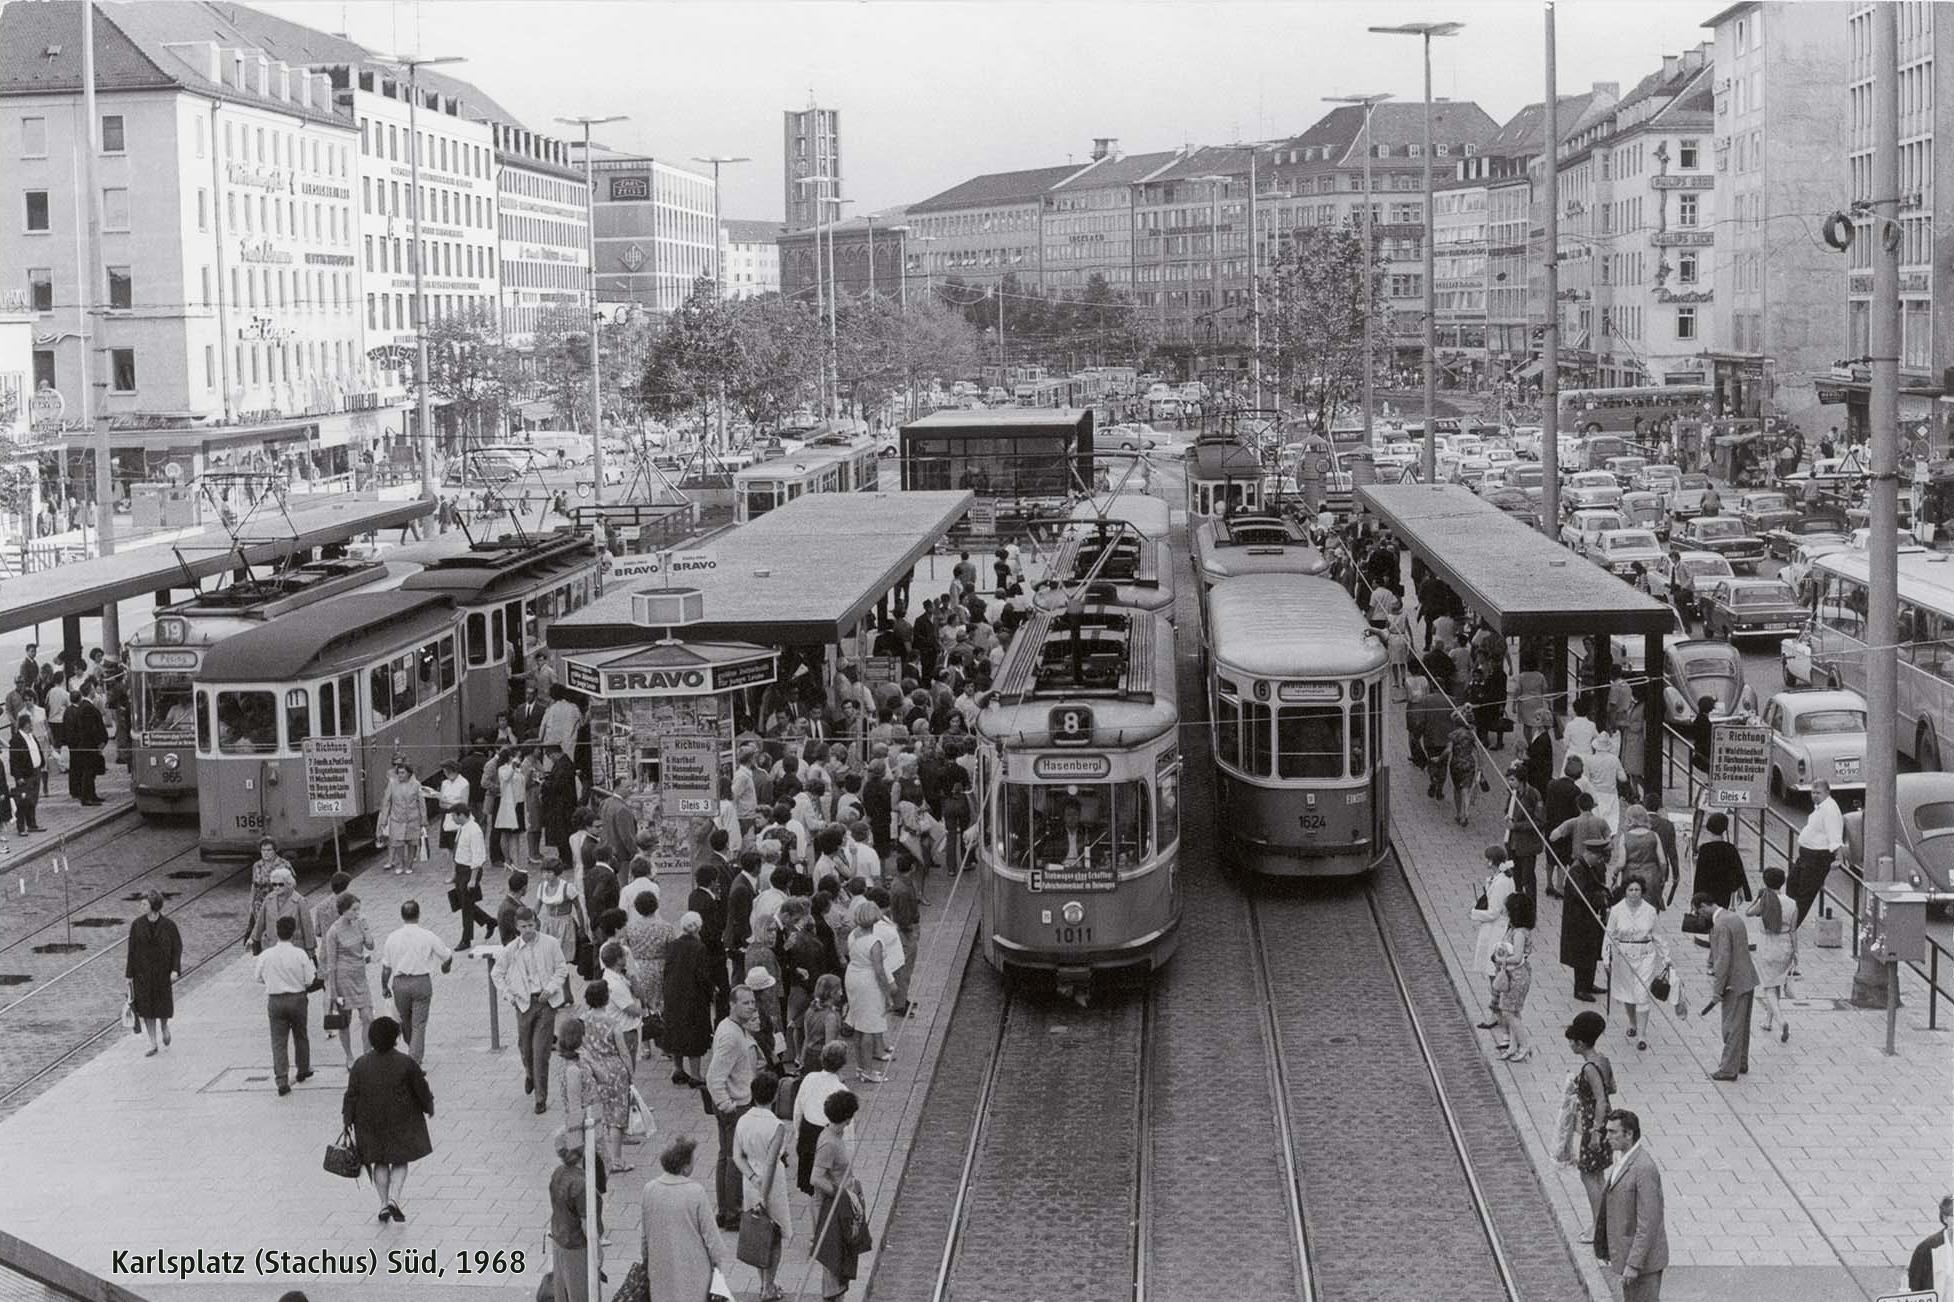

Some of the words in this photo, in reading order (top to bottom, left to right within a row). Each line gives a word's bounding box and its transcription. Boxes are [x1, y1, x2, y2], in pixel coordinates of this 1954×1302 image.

[1765, 418, 1776, 432] P
[614, 565, 659, 577] BRAVO
[673, 561, 717, 571] BRAVO
[162, 622, 181, 639] 19
[607, 671, 705, 690] BRAVO
[1259, 683, 1266, 697] 6
[288, 689, 299, 706] 11
[1064, 712, 1079, 734] 8
[1729, 731, 1765, 744] Richtung
[316, 742, 347, 753] Richtung
[674, 740, 710, 752] Richtung
[1043, 760, 1102, 772] Hasenbergl
[1723, 773, 1754, 782] Grünwald
[1720, 792, 1739, 801] Gleis
[1742, 792, 1747, 800] 4
[316, 801, 333, 811] Gleis
[334, 801, 340, 811] 2
[681, 800, 700, 810] Gleis
[703, 800, 709, 810] 3
[1299, 816, 1326, 828] 1624
[1031, 872, 1040, 890] E
[1056, 928, 1091, 943] 1011
